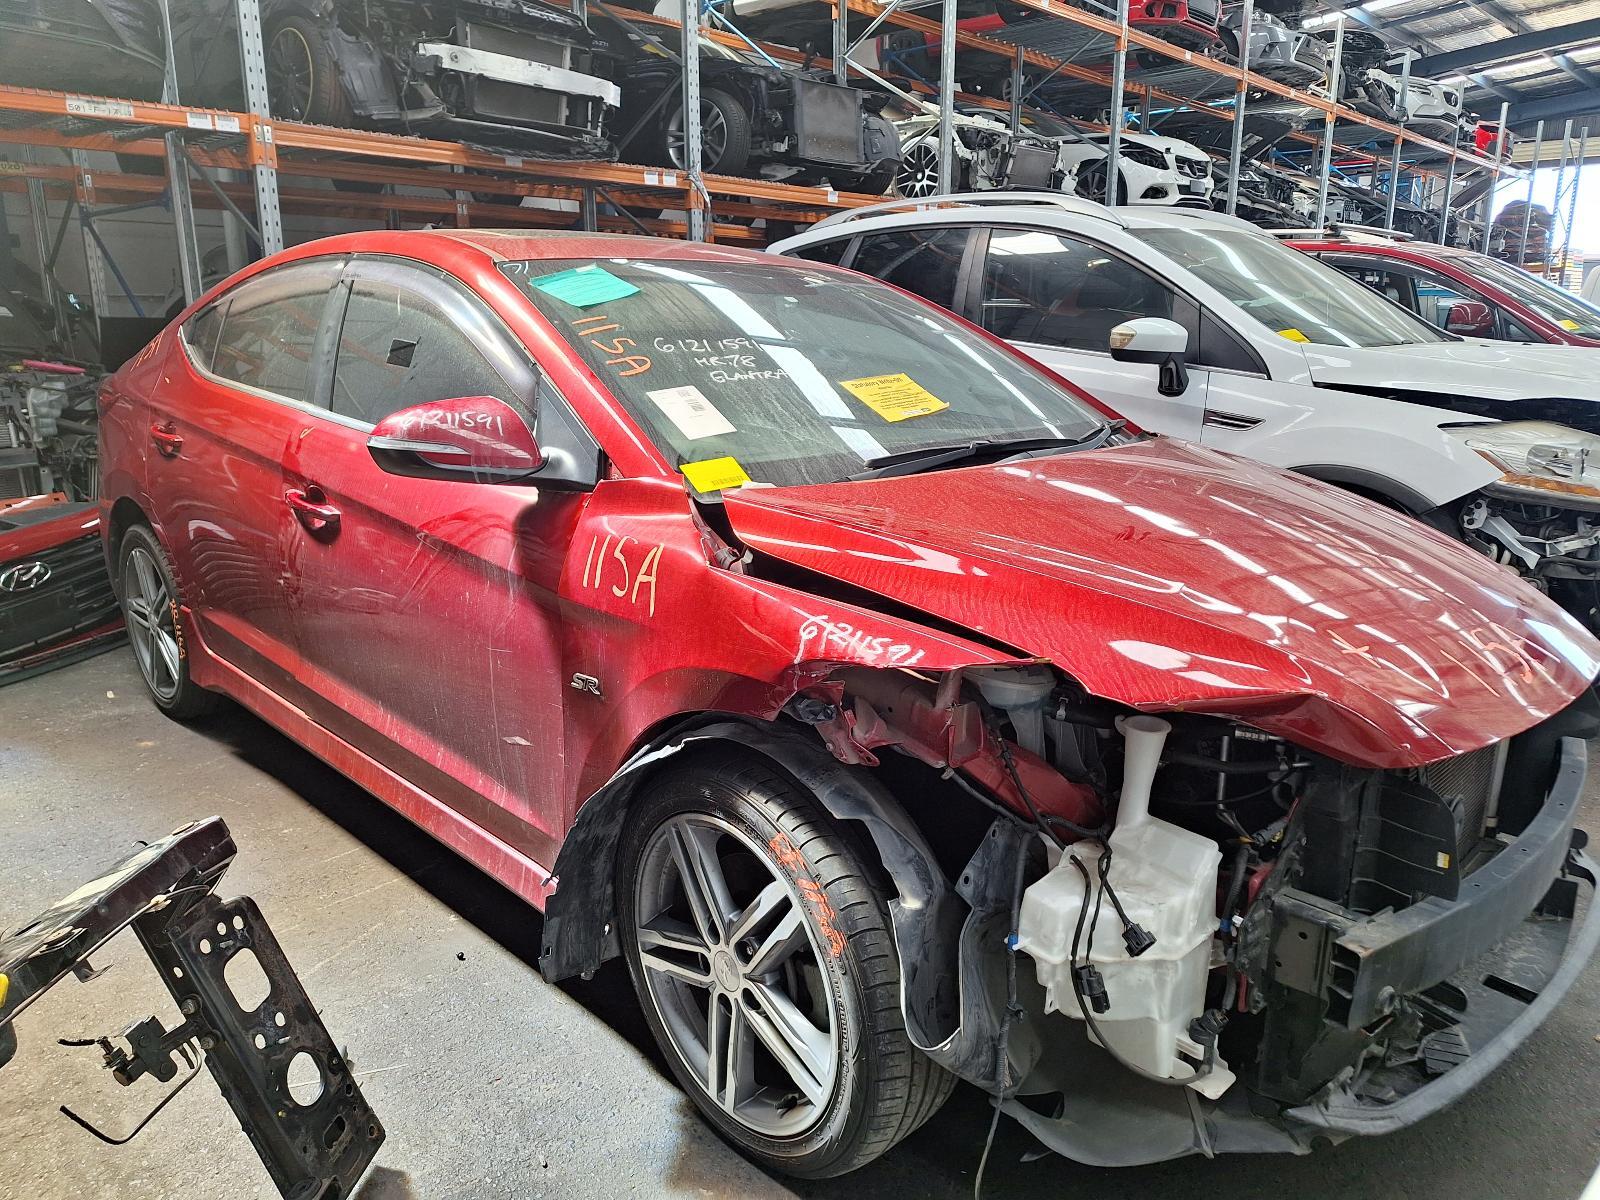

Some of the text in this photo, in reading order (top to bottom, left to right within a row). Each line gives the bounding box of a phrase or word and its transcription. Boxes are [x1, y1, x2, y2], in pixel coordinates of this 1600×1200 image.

[709, 368, 789, 384] ELANTRA
[582, 533, 666, 618] 115A
[570, 671, 602, 696] SR
